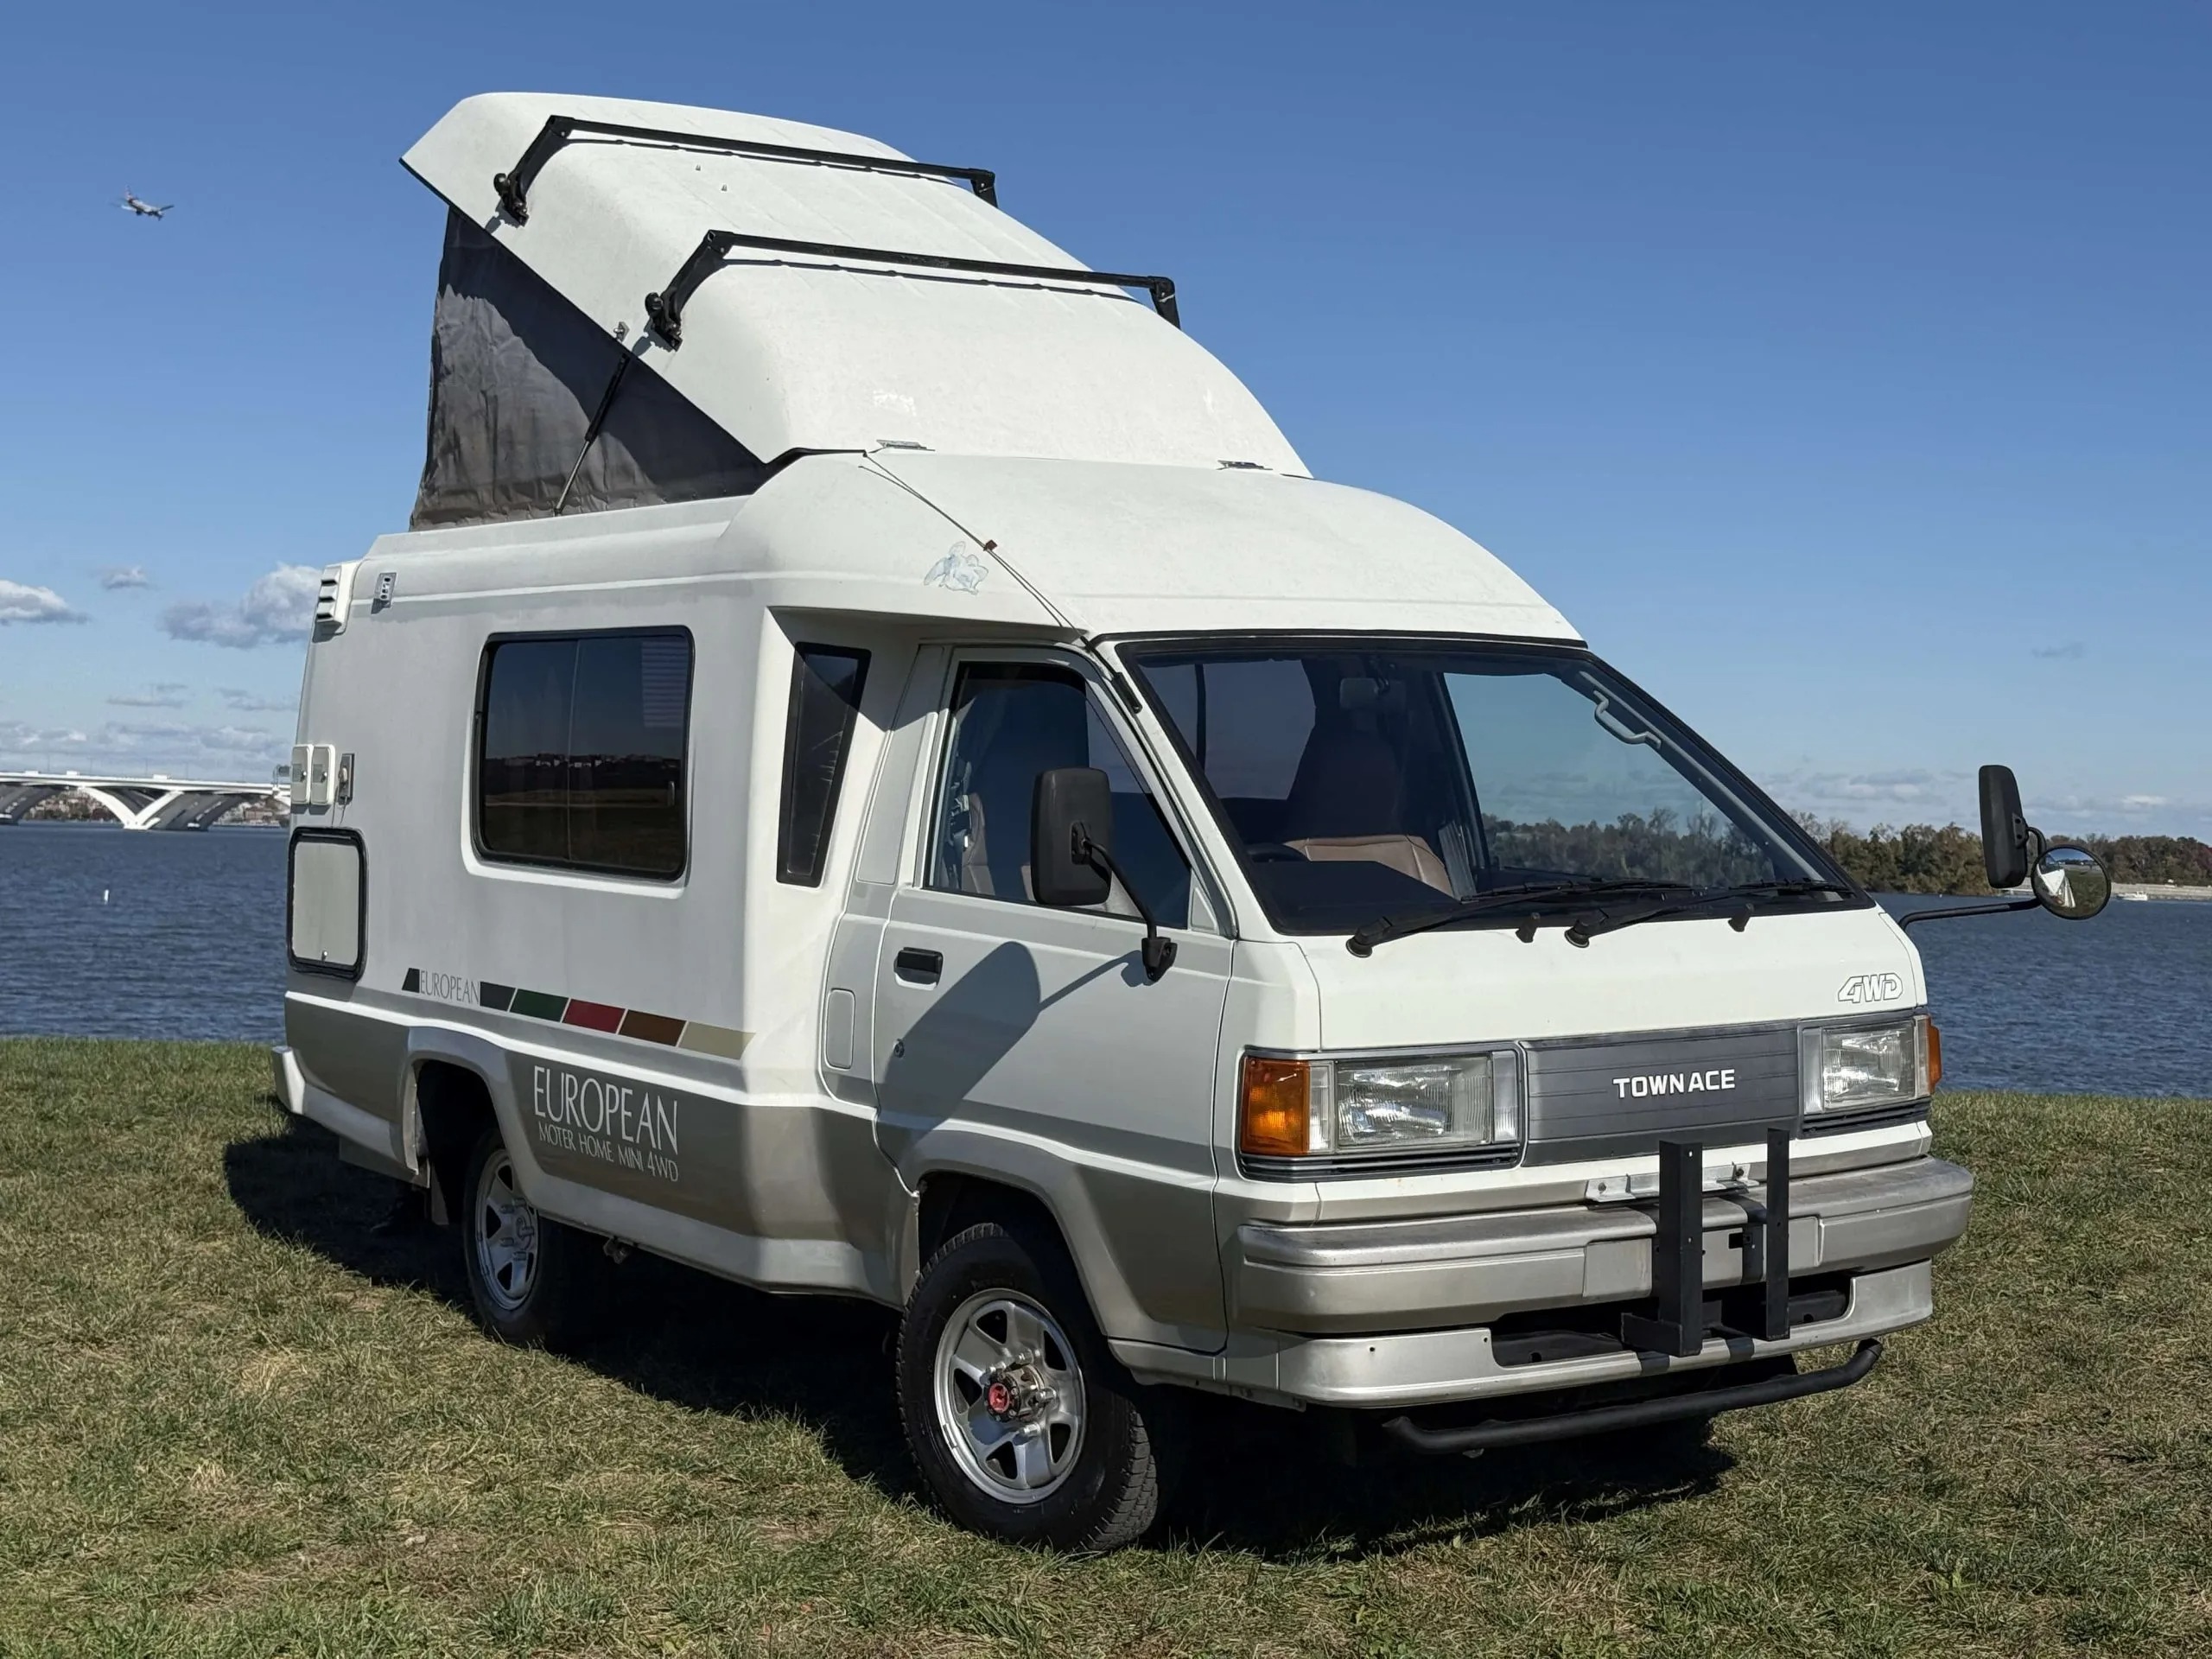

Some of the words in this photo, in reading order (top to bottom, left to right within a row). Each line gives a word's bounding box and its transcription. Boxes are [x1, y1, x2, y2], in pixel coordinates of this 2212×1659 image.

[420, 970, 480, 1005] EUROPEAN
[1838, 972, 1904, 1004] 4WD
[534, 1065, 678, 1155] EUROPEAN
[538, 1121, 576, 1151] MOTER
[578, 1132, 614, 1162] HOME
[617, 1143, 644, 1172] MINI
[648, 1150, 679, 1182] 4WD
